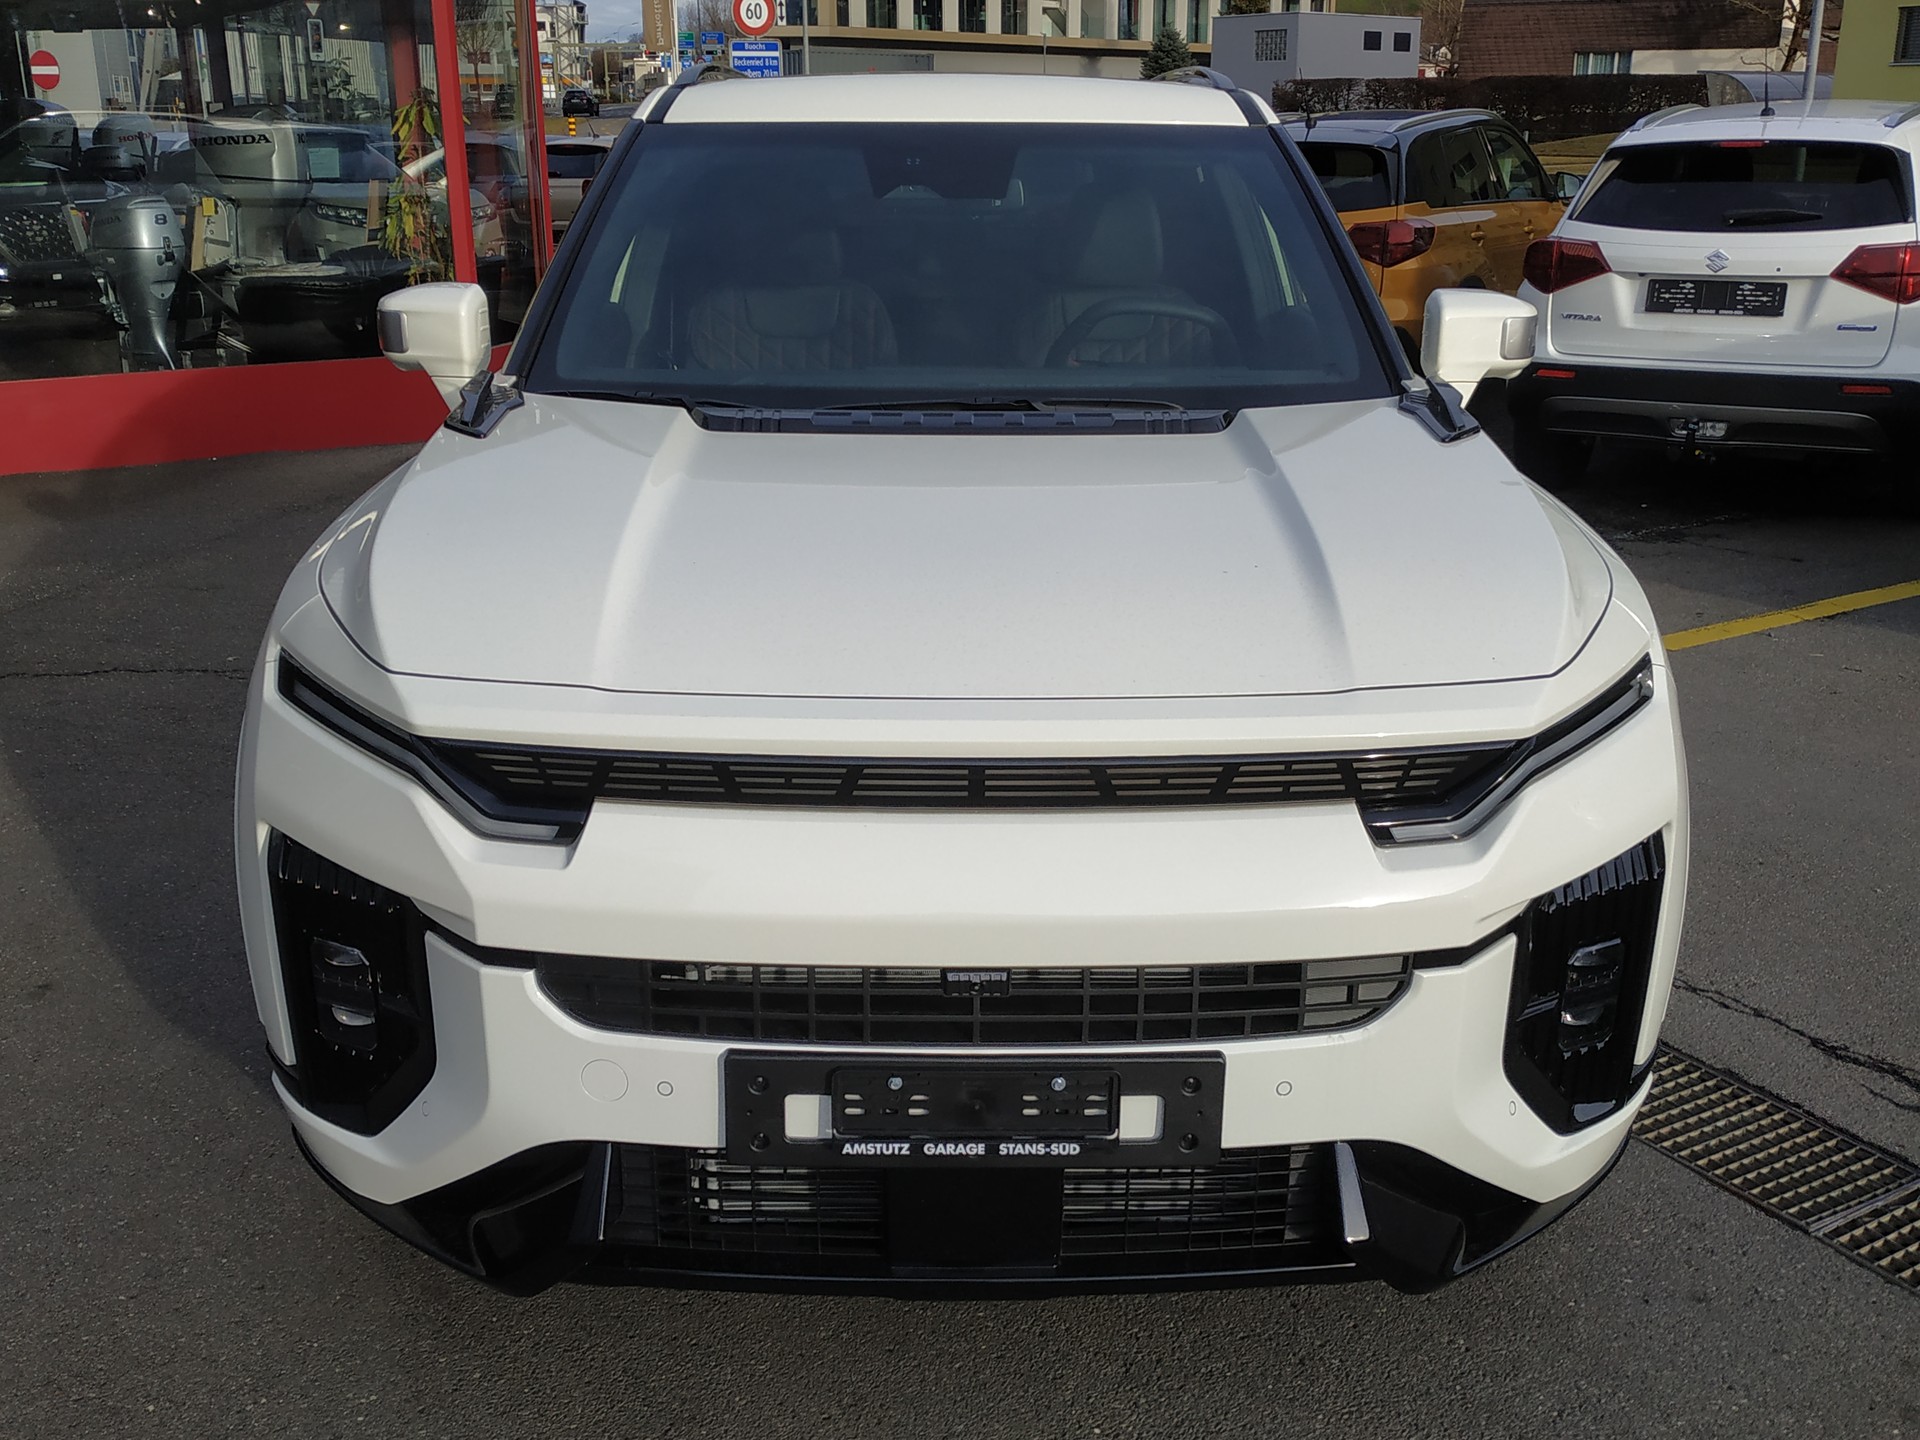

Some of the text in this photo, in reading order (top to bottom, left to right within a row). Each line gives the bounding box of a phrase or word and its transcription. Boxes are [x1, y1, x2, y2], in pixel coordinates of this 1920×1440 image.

[745, 2, 763, 20] 60
[744, 42, 766, 50] Buochs
[734, 57, 764, 67] Beckenried
[770, 57, 778, 67] km
[771, 69, 778, 77] km
[200, 133, 272, 147] HONDA
[154, 213, 168, 225] 8
[1561, 313, 1601, 322] VITARA
[842, 1143, 1080, 1155] AMSTUTZ GARAGE STANS-SÜD
